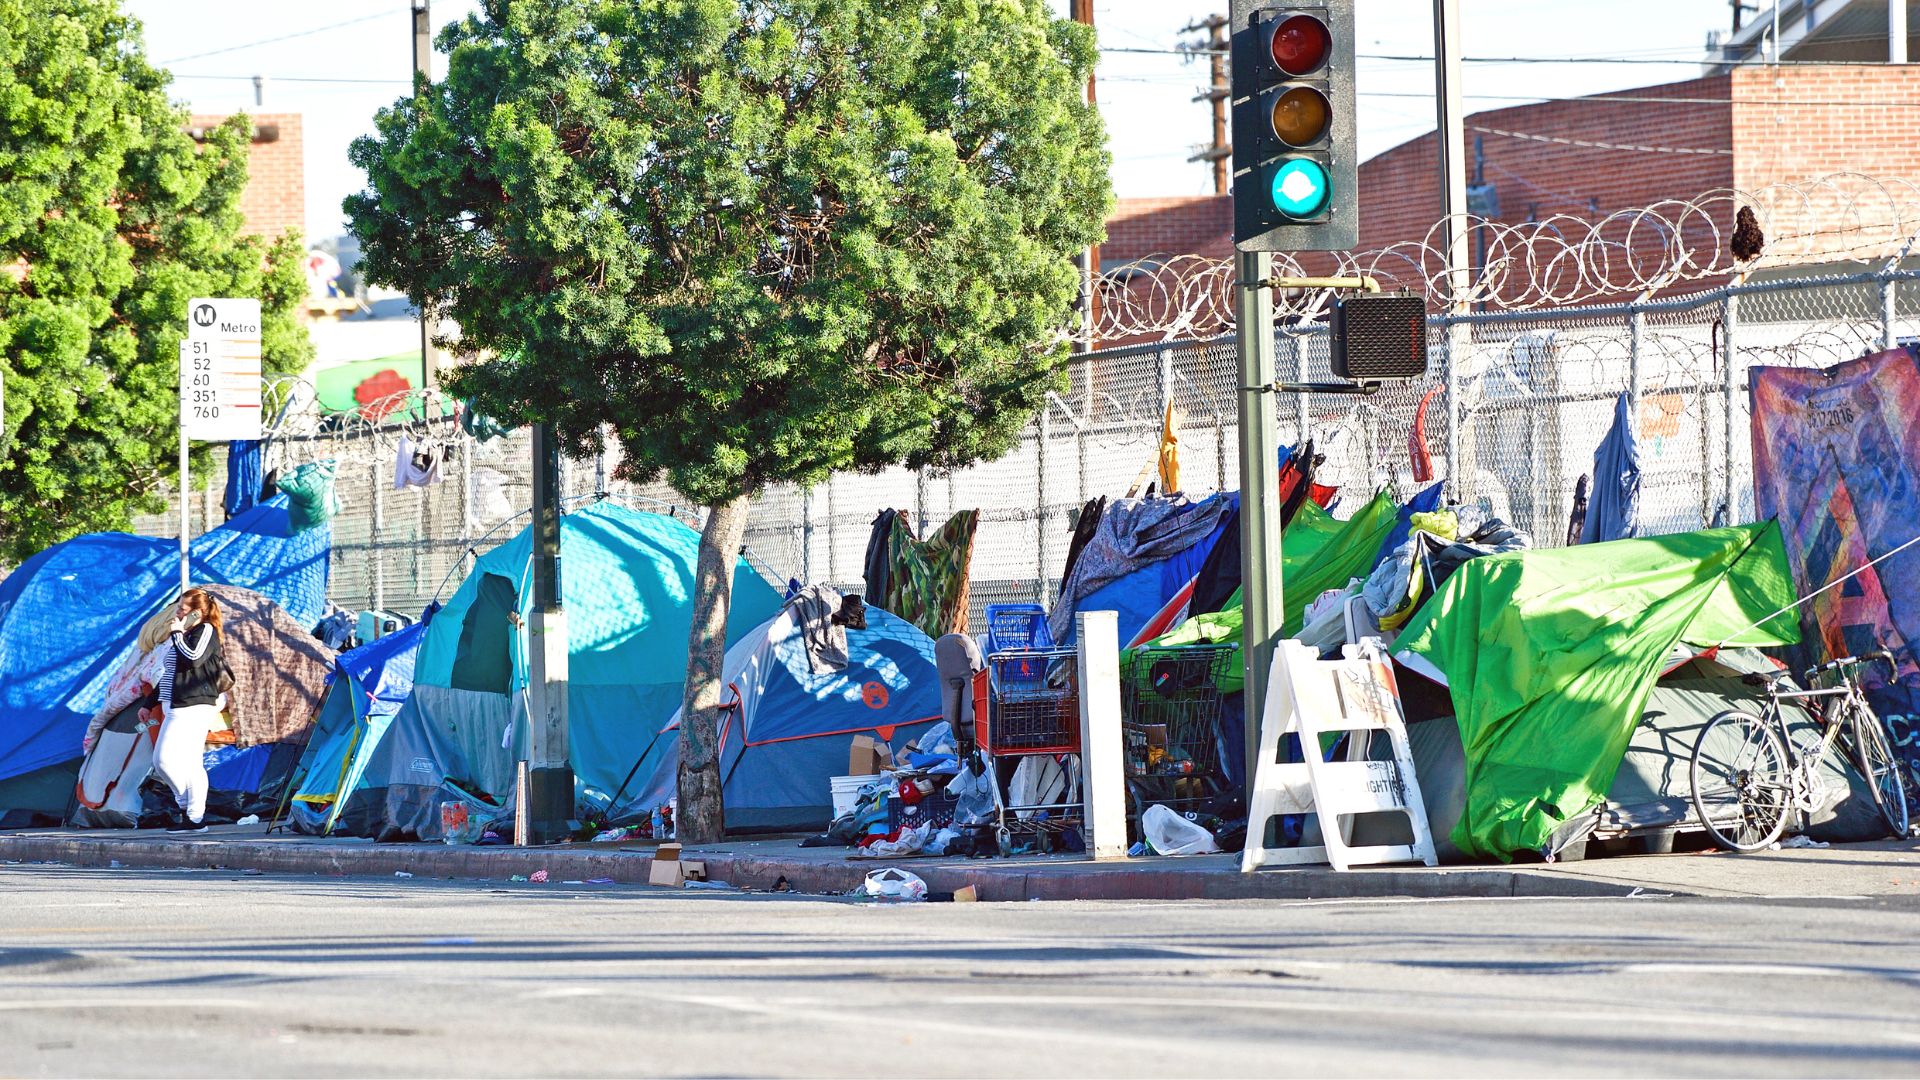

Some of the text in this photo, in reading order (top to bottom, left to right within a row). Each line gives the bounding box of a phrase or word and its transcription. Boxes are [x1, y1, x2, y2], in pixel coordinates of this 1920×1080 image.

[221, 322, 256, 333] Metro
[193, 341, 208, 354] 51
[193, 358, 211, 370] 52
[193, 373, 210, 386] 60
[193, 390, 216, 403] 351
[193, 406, 219, 419] 760
[1364, 779, 1406, 793] IGHTING
